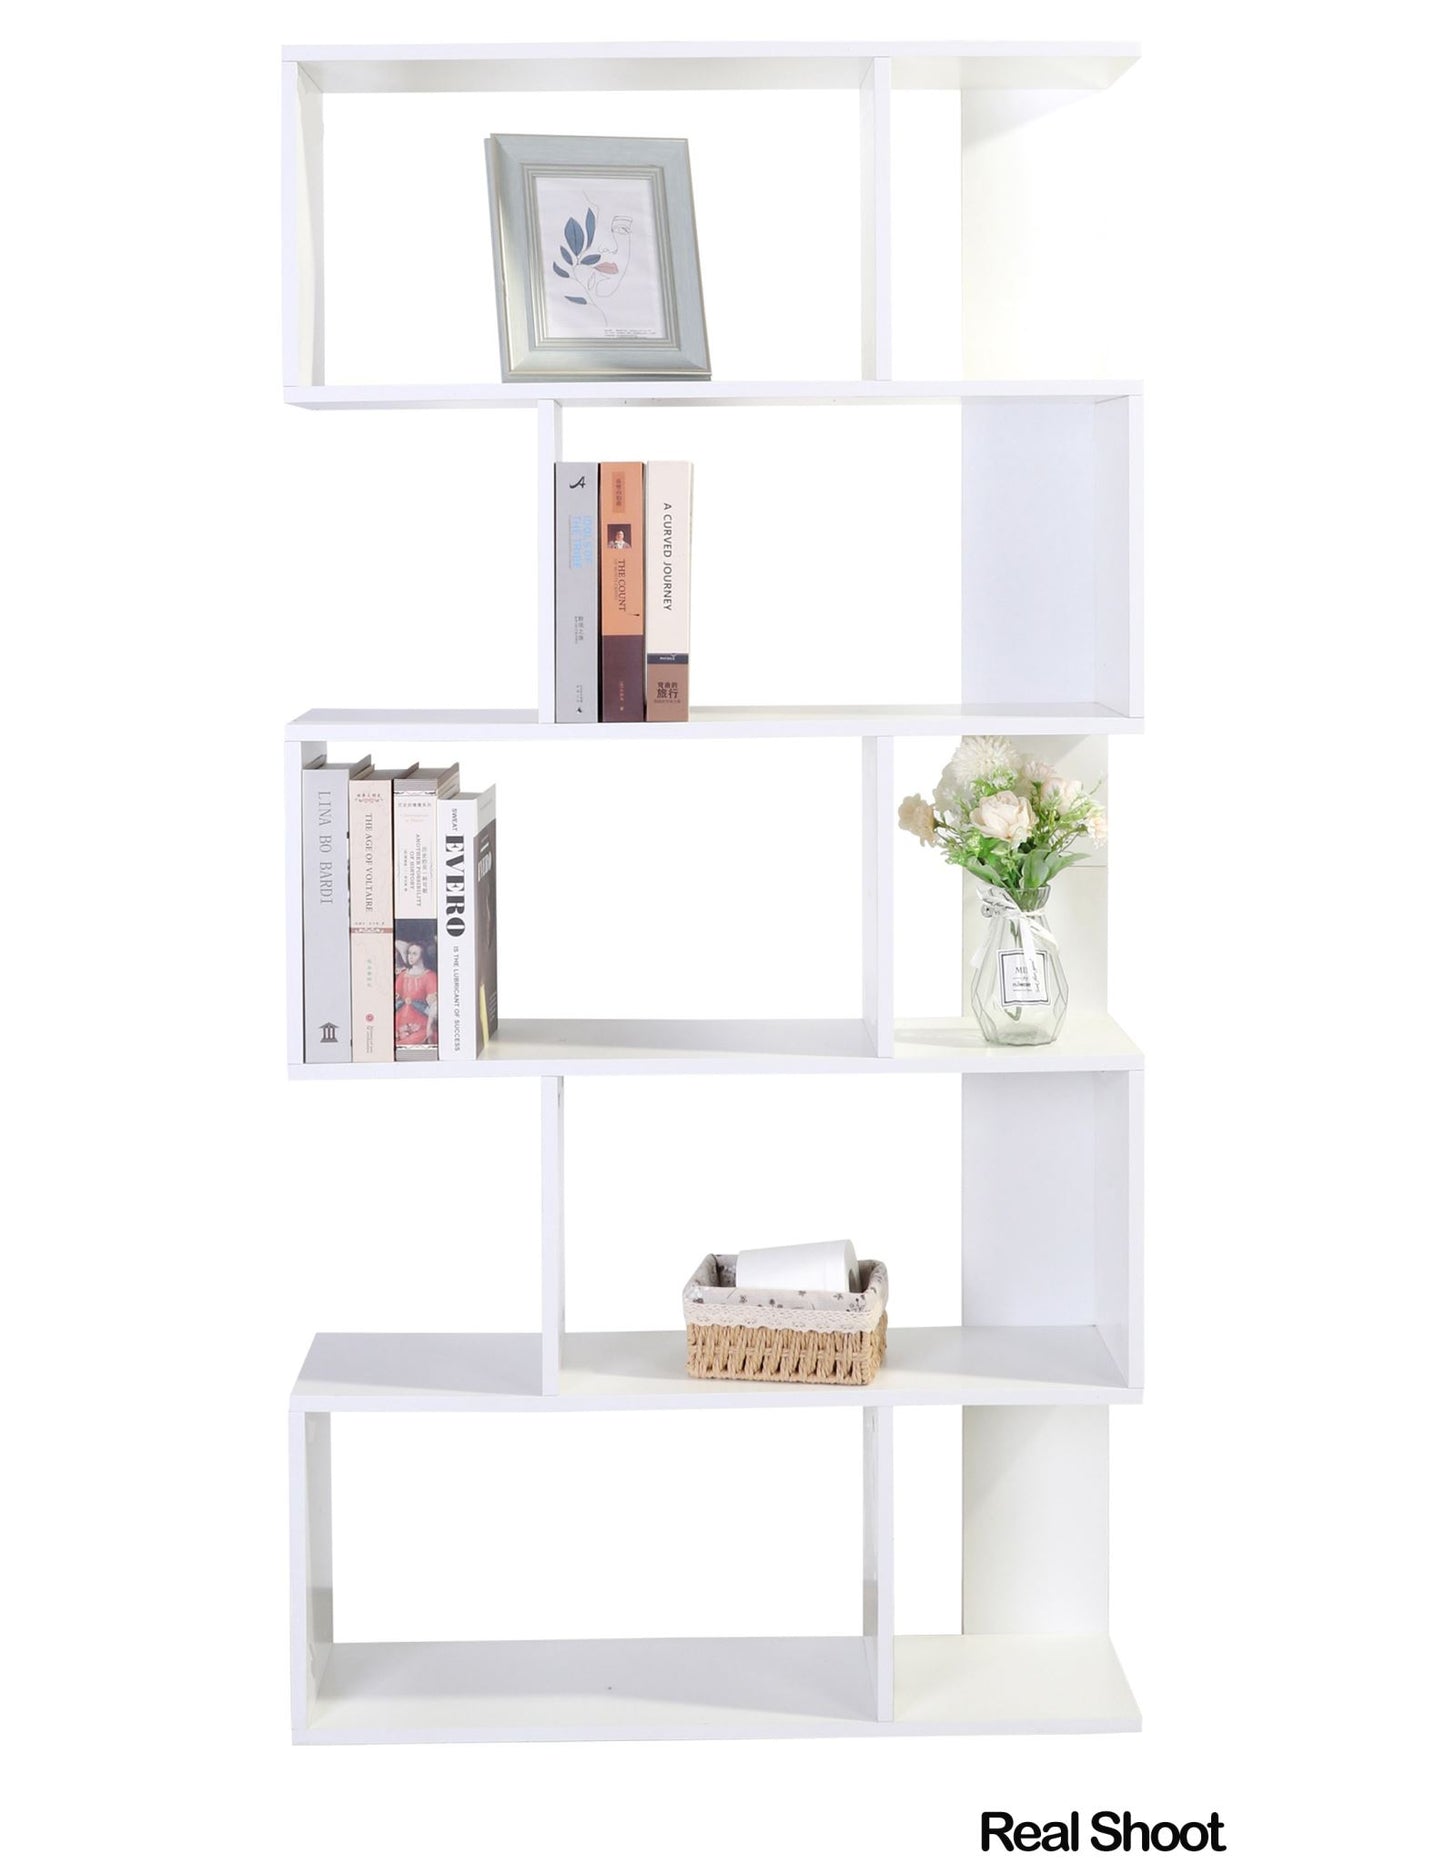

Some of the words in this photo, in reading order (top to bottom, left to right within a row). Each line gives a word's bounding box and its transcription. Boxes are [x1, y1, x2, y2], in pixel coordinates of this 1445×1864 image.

[663, 502, 673, 511] A
[663, 514, 673, 558] CURVED
[618, 558, 626, 577] THE
[663, 561, 673, 611] JOURNEY
[618, 579, 626, 613] COUNT
[656, 688, 679, 699] 旅行
[317, 791, 332, 827] LINA
[365, 813, 373, 831] THE
[319, 835, 333, 853] BO
[365, 833, 373, 852] AGE
[365, 853, 373, 864] OF
[320, 862, 334, 905] BARDI
[365, 867, 374, 912] VOLTAIRE
[446, 835, 465, 937] EVERO
[453, 945, 459, 953] IS
[454, 1007, 460, 1018] OF
